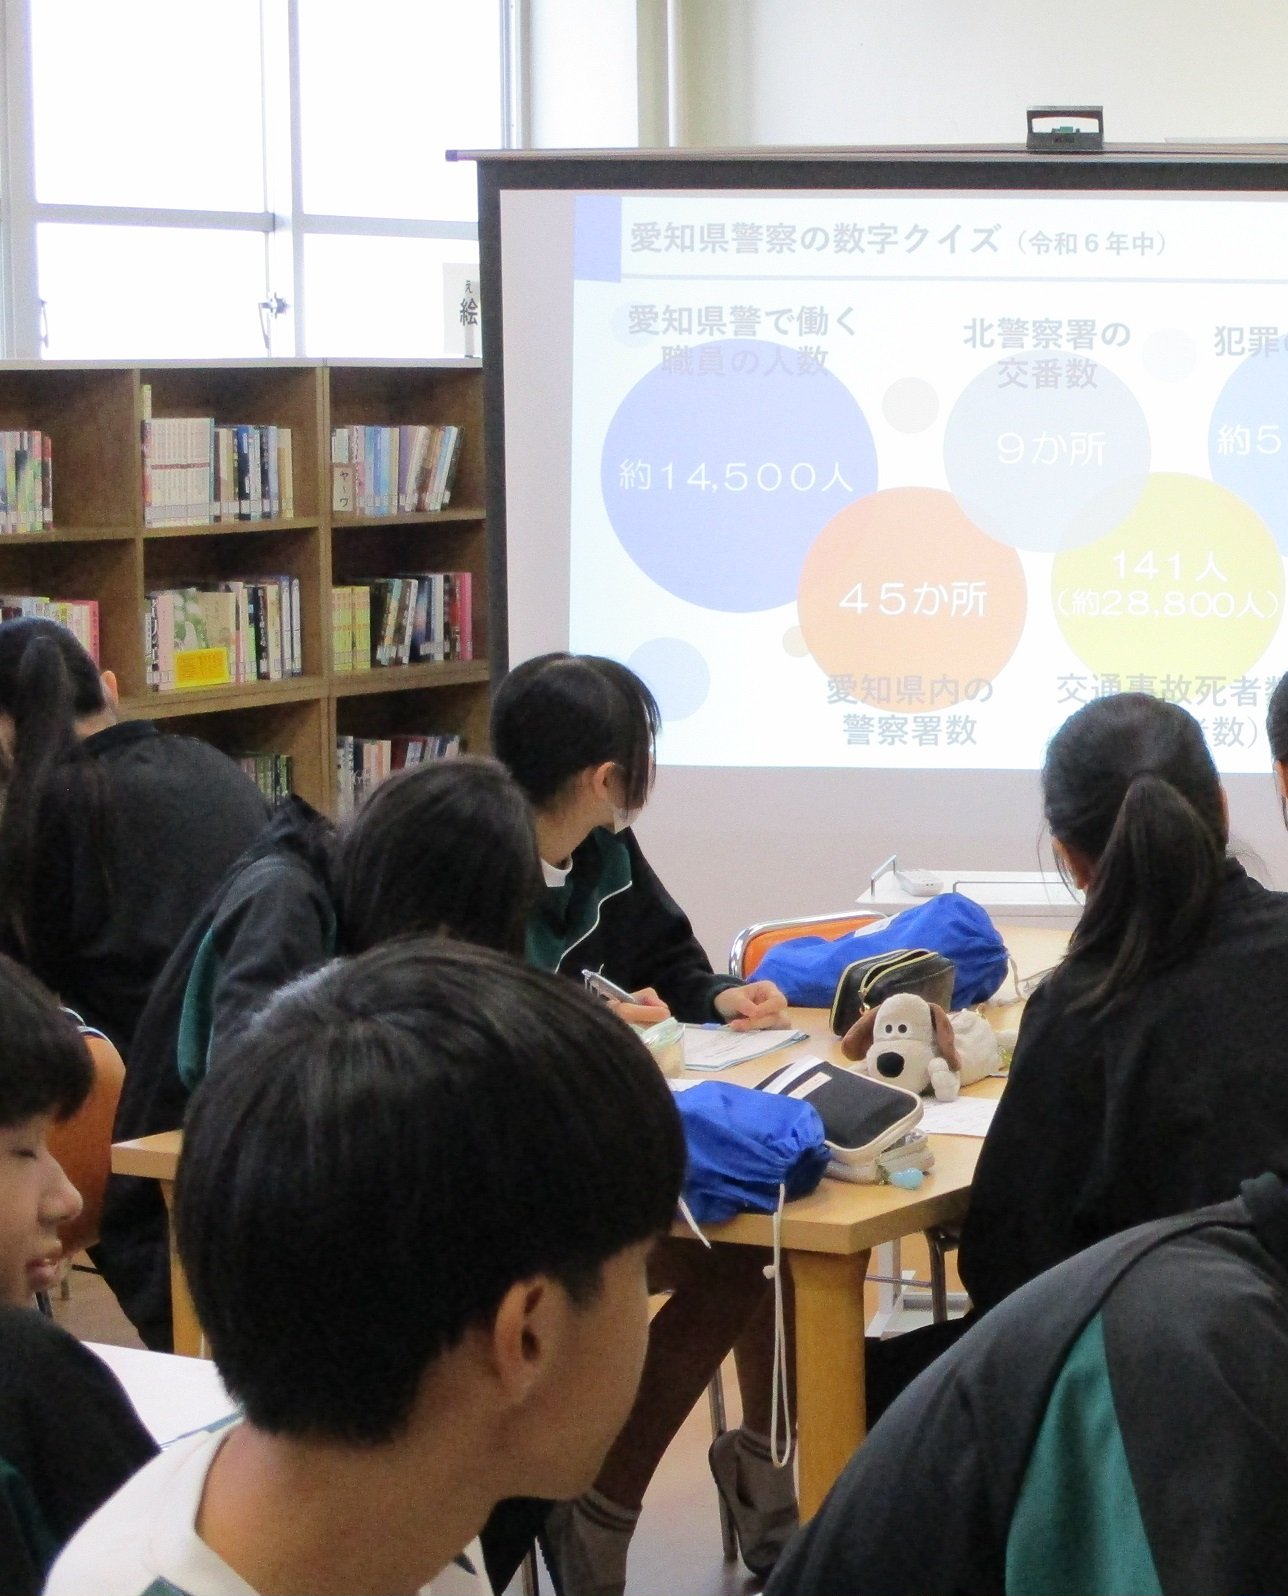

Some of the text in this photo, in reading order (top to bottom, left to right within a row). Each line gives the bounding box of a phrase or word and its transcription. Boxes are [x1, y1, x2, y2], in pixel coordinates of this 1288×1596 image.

[460, 298, 478, 326] 絵
[628, 305, 857, 338] 愛知県警で働く
[963, 317, 1131, 351] 北警察署の
[661, 345, 829, 378] 職員の人数
[997, 357, 1099, 390] 交番数
[996, 431, 1107, 467] 9か所
[619, 458, 854, 493] 約14,500人
[1112, 550, 1229, 584] 141人
[839, 581, 988, 617] 45か所
[826, 673, 994, 705] 愛知県内の
[842, 714, 978, 747] 警察署数
